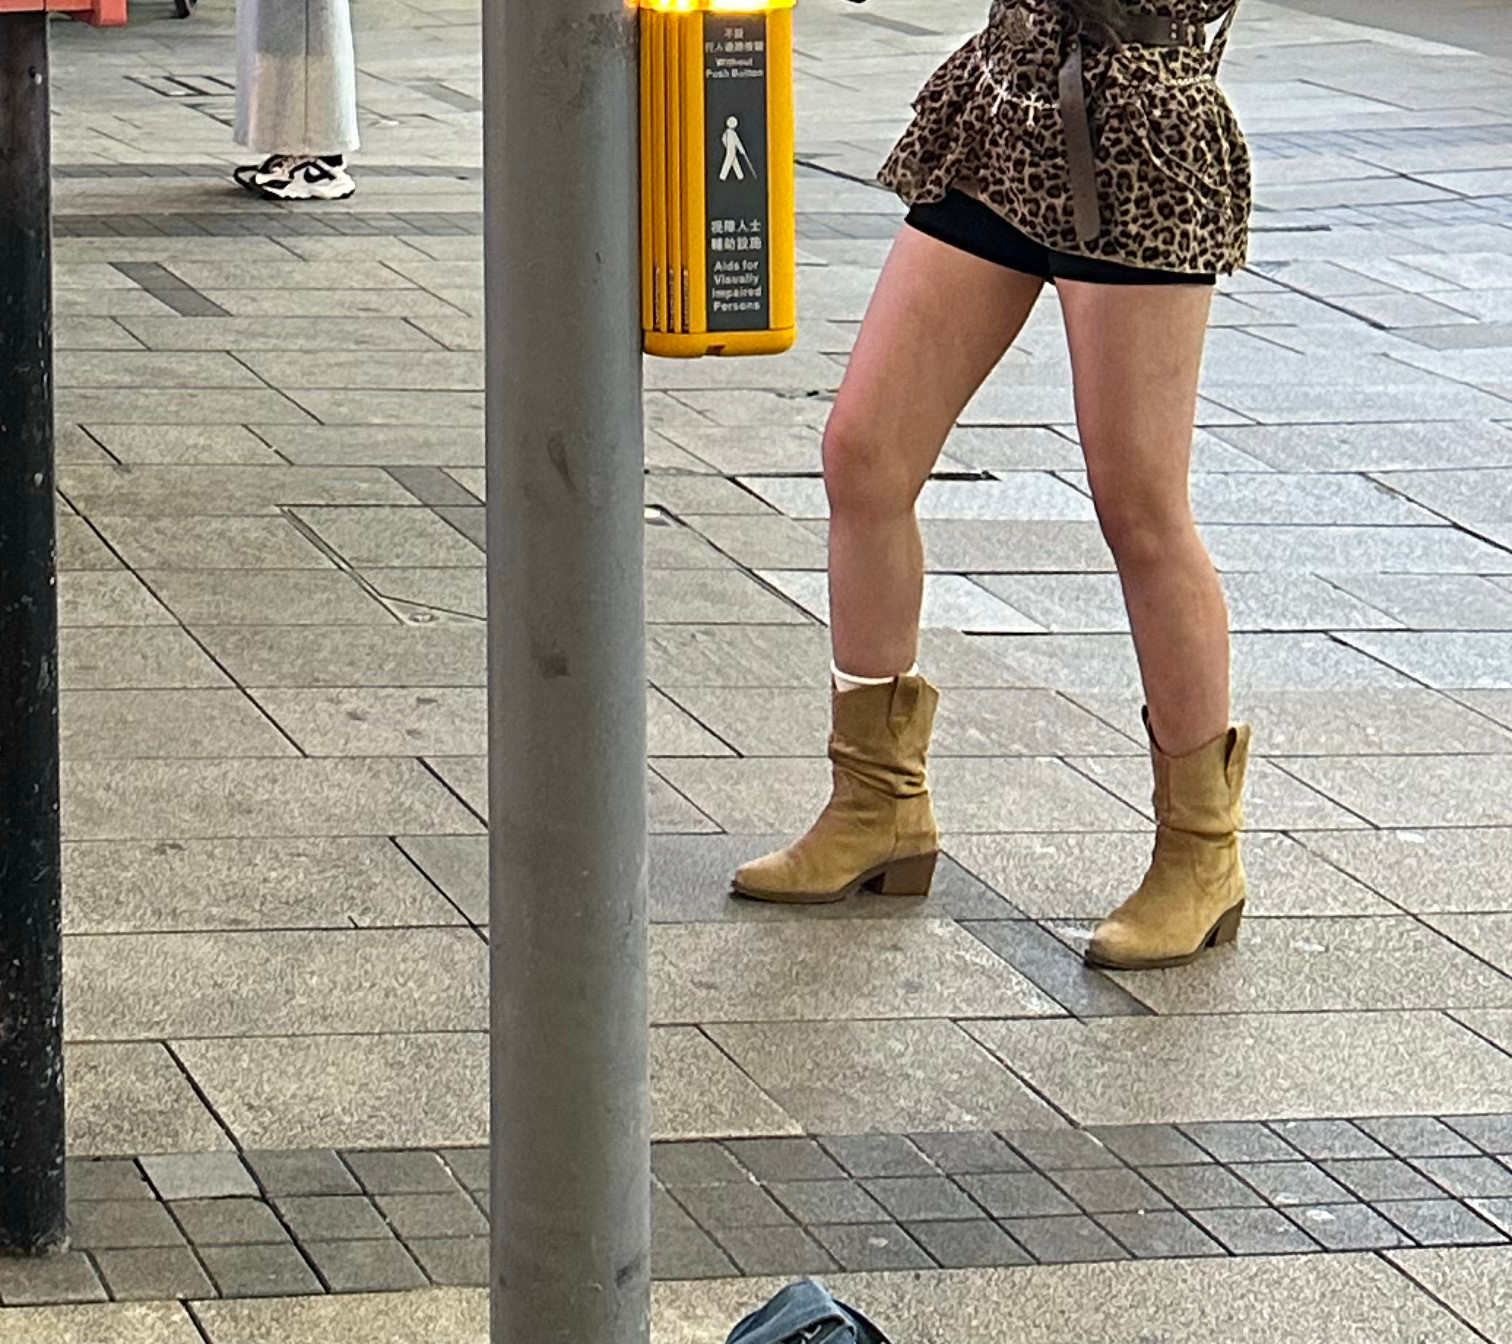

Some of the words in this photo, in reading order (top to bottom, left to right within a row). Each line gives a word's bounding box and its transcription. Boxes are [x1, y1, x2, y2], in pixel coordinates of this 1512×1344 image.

[706, 69, 729, 79] Push
[731, 68, 764, 79] Button
[714, 261, 740, 271] Aids
[742, 260, 758, 271] for
[713, 273, 759, 286] Visually
[712, 286, 762, 300] Impaired
[713, 301, 761, 312] Persons
